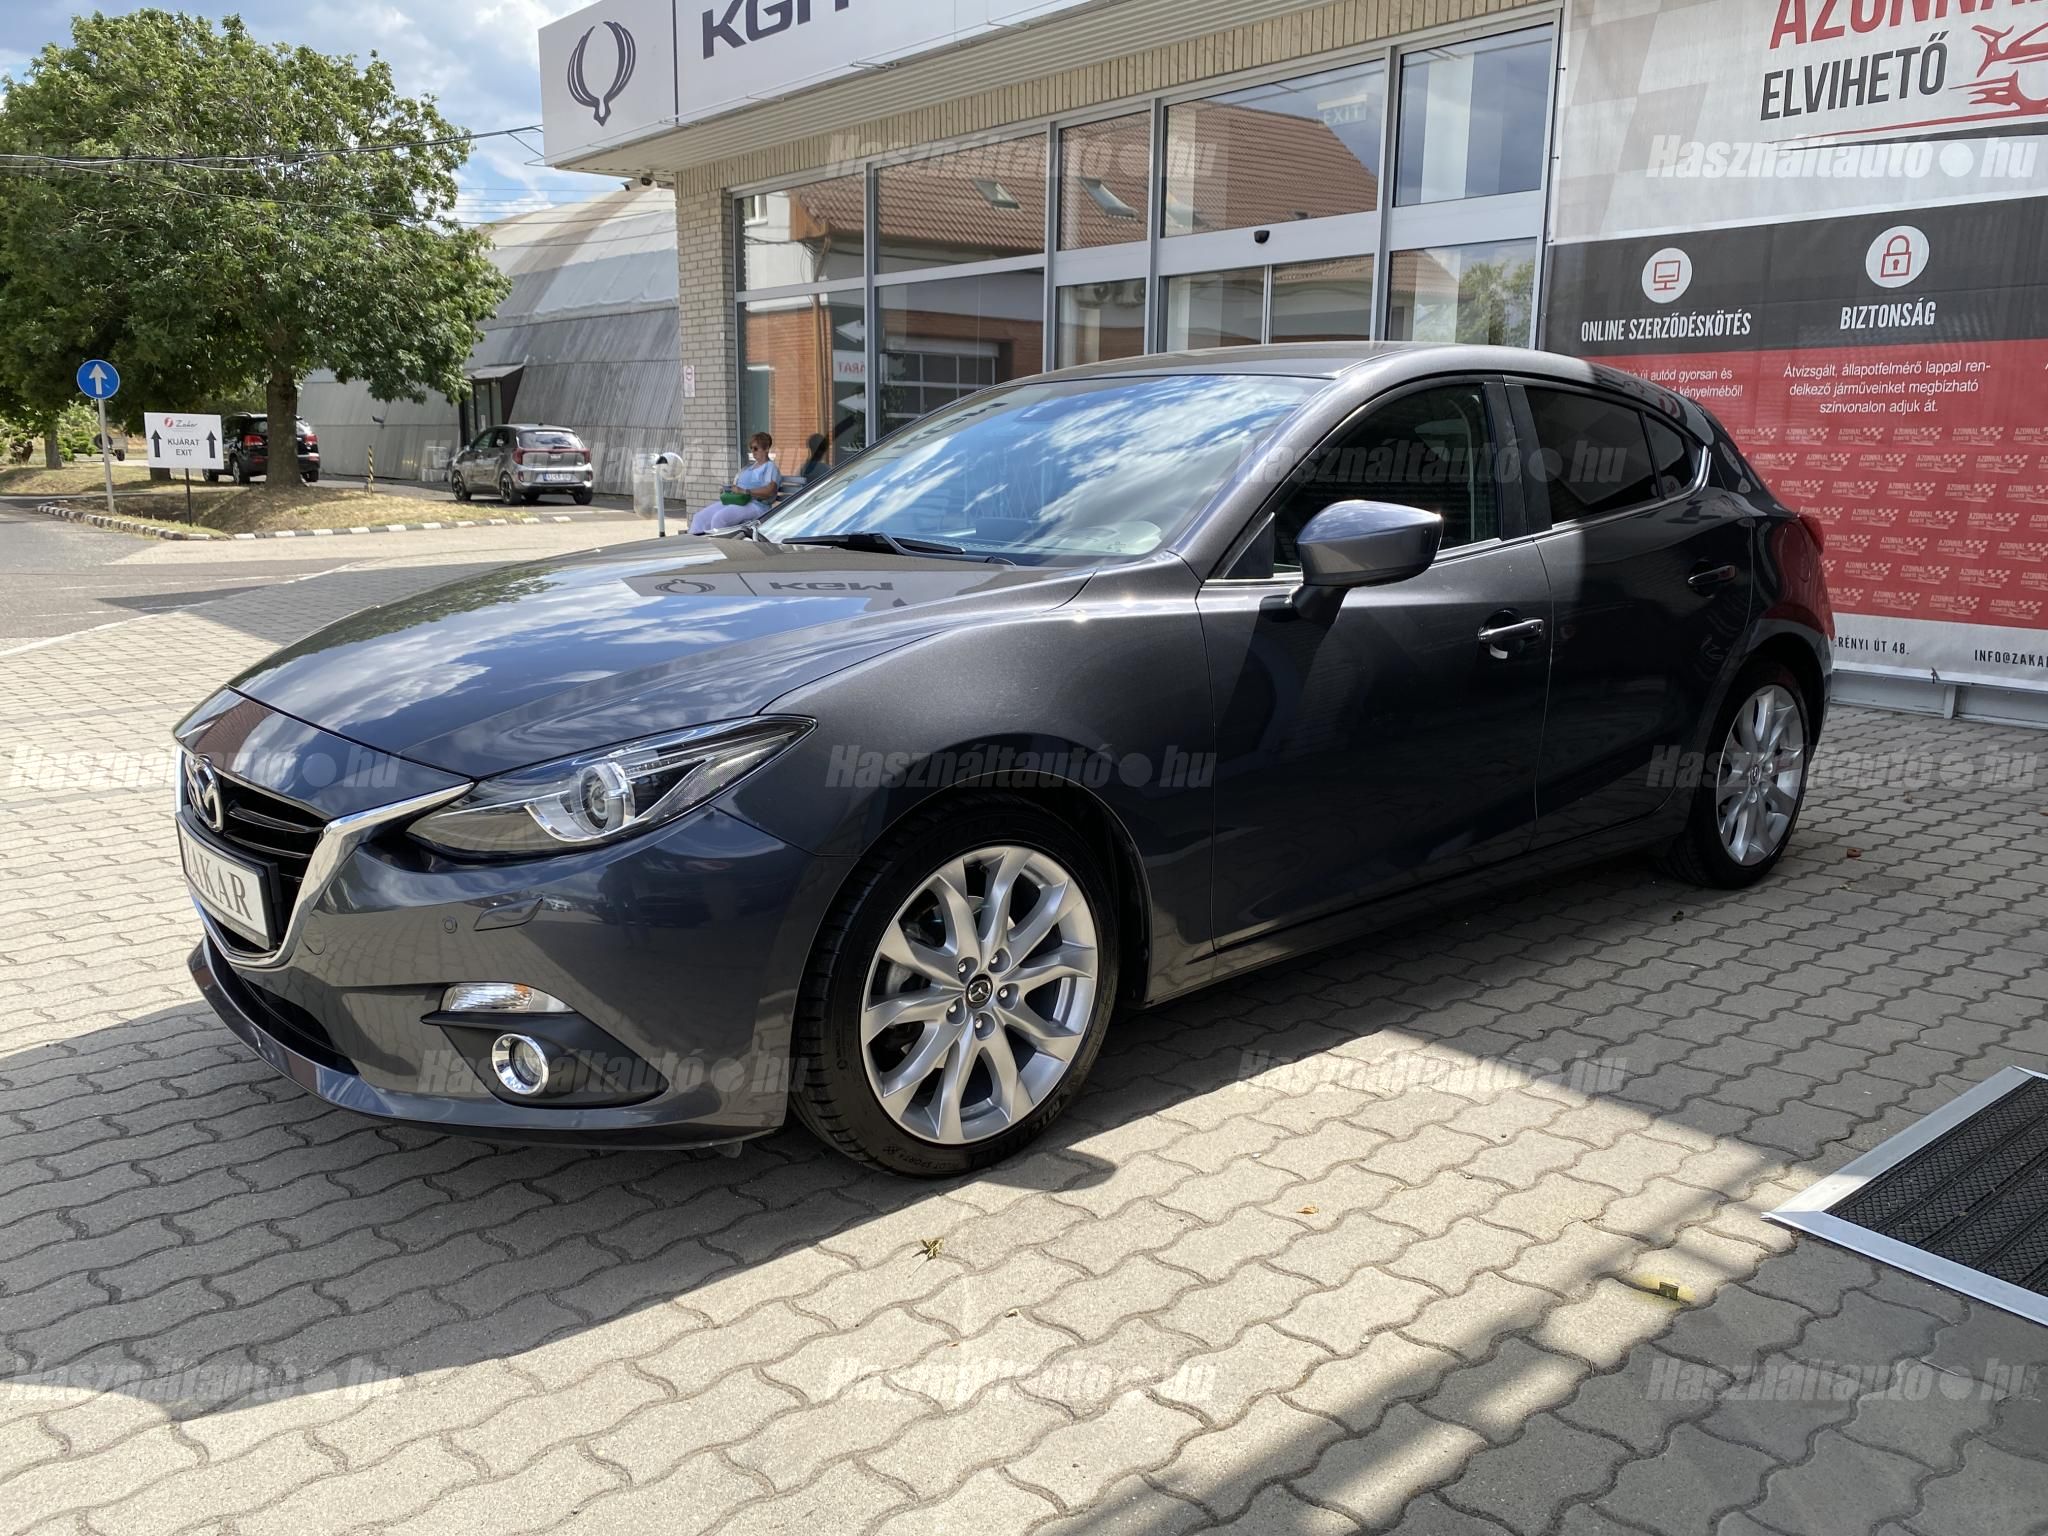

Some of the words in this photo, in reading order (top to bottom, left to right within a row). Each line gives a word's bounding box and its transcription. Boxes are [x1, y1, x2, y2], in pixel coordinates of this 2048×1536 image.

[1760, 30, 1949, 121] ELVIHETŐ
[1840, 301, 1937, 330] BIZTONSÁG
[1581, 319, 1626, 342] ONLINE
[1629, 309, 1752, 340] SZERZŐDÉSKÖTÉS
[1651, 369, 1677, 381] autód
[1679, 370, 1718, 383] gyorsan
[1720, 368, 1733, 380] és
[1783, 363, 1838, 380] Átvizsgált,
[1842, 361, 1922, 378] állapotfelmérő
[1925, 360, 1962, 377] lappal
[1965, 361, 1991, 373] ren-
[1680, 385, 1743, 399] kényelméből!
[1789, 381, 1831, 396] delkező
[1833, 380, 1906, 398] járműveinket
[1909, 378, 1979, 397] megbízható
[1819, 399, 1886, 414] színvonalon
[1889, 399, 1921, 416] adjuk
[1924, 398, 1939, 412] át.
[175, 448, 193, 456] EXIT
[1873, 637, 1887, 654] ÚT
[1892, 642, 1910, 656] 48.
